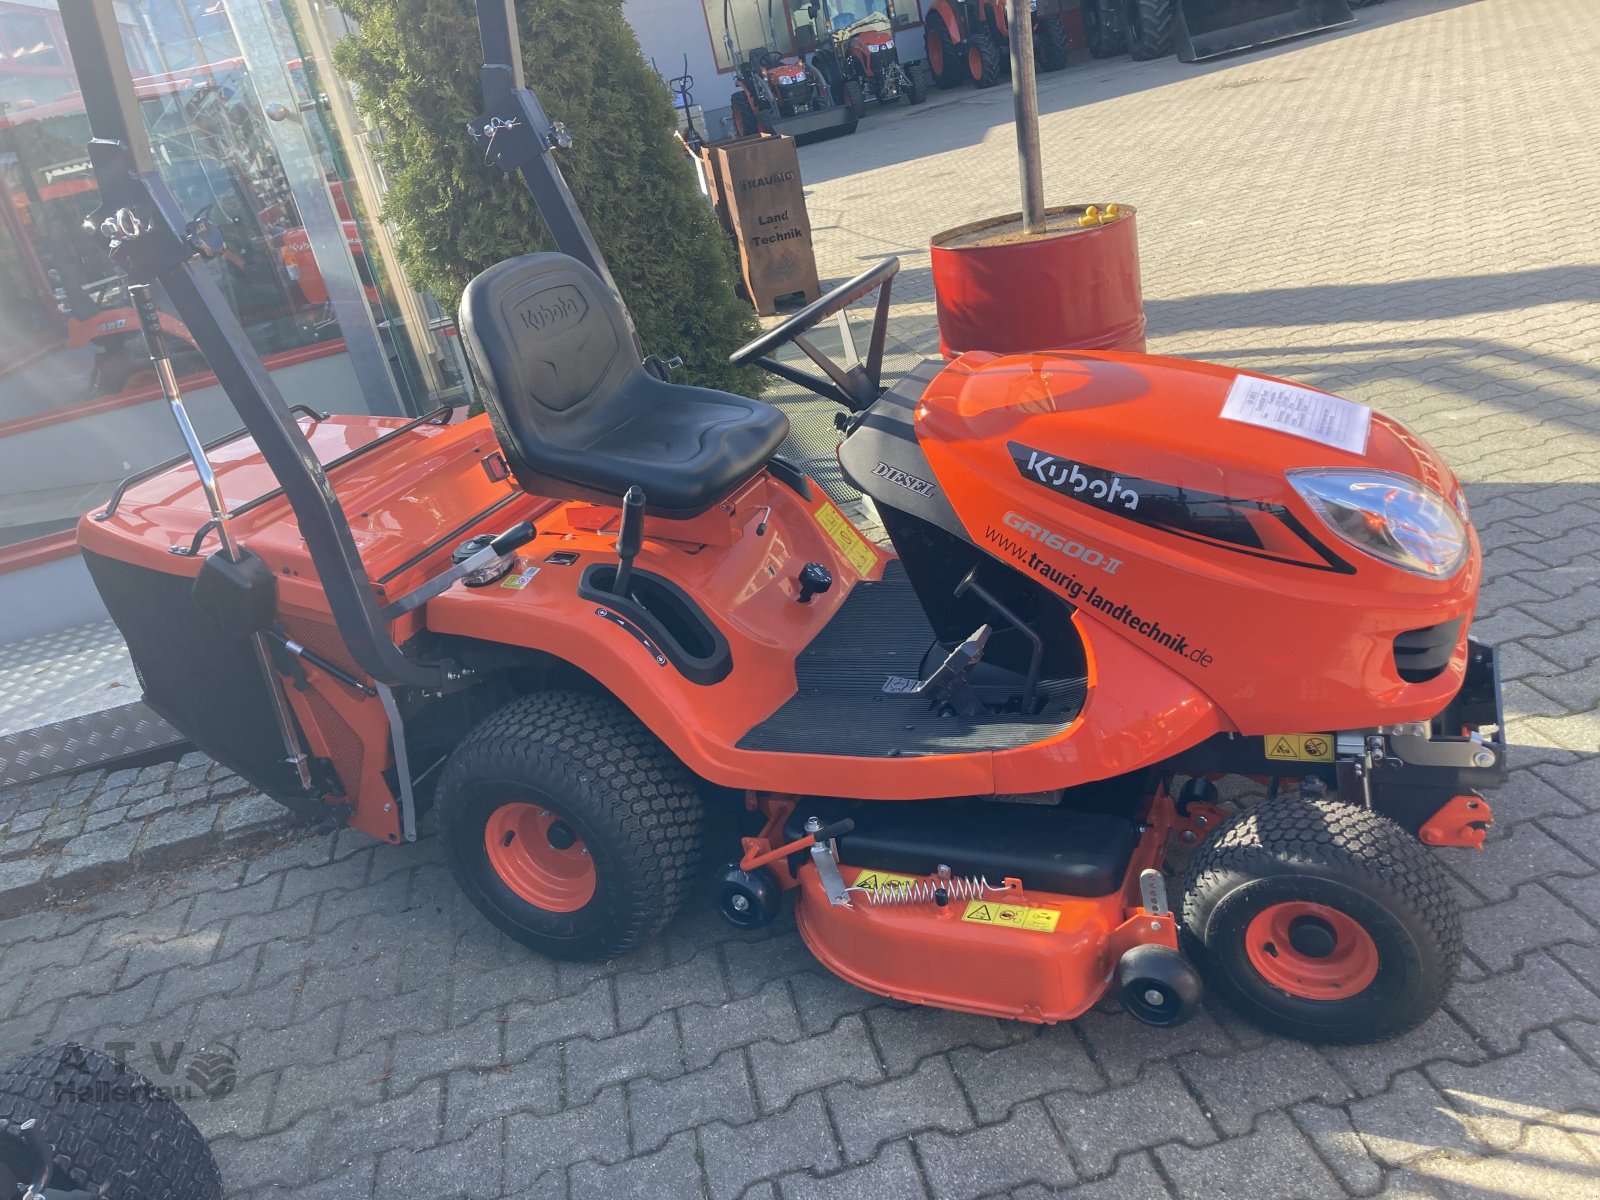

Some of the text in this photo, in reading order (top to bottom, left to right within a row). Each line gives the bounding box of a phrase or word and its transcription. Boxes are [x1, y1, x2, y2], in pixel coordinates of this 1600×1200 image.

[758, 211, 788, 225] Land
[752, 228, 802, 246] Technik
[520, 297, 578, 330] Kubota
[871, 461, 936, 498] DIESEL
[1027, 452, 1139, 510] Kubota
[985, 525, 1213, 668] www.traurig-landtechnik.de
